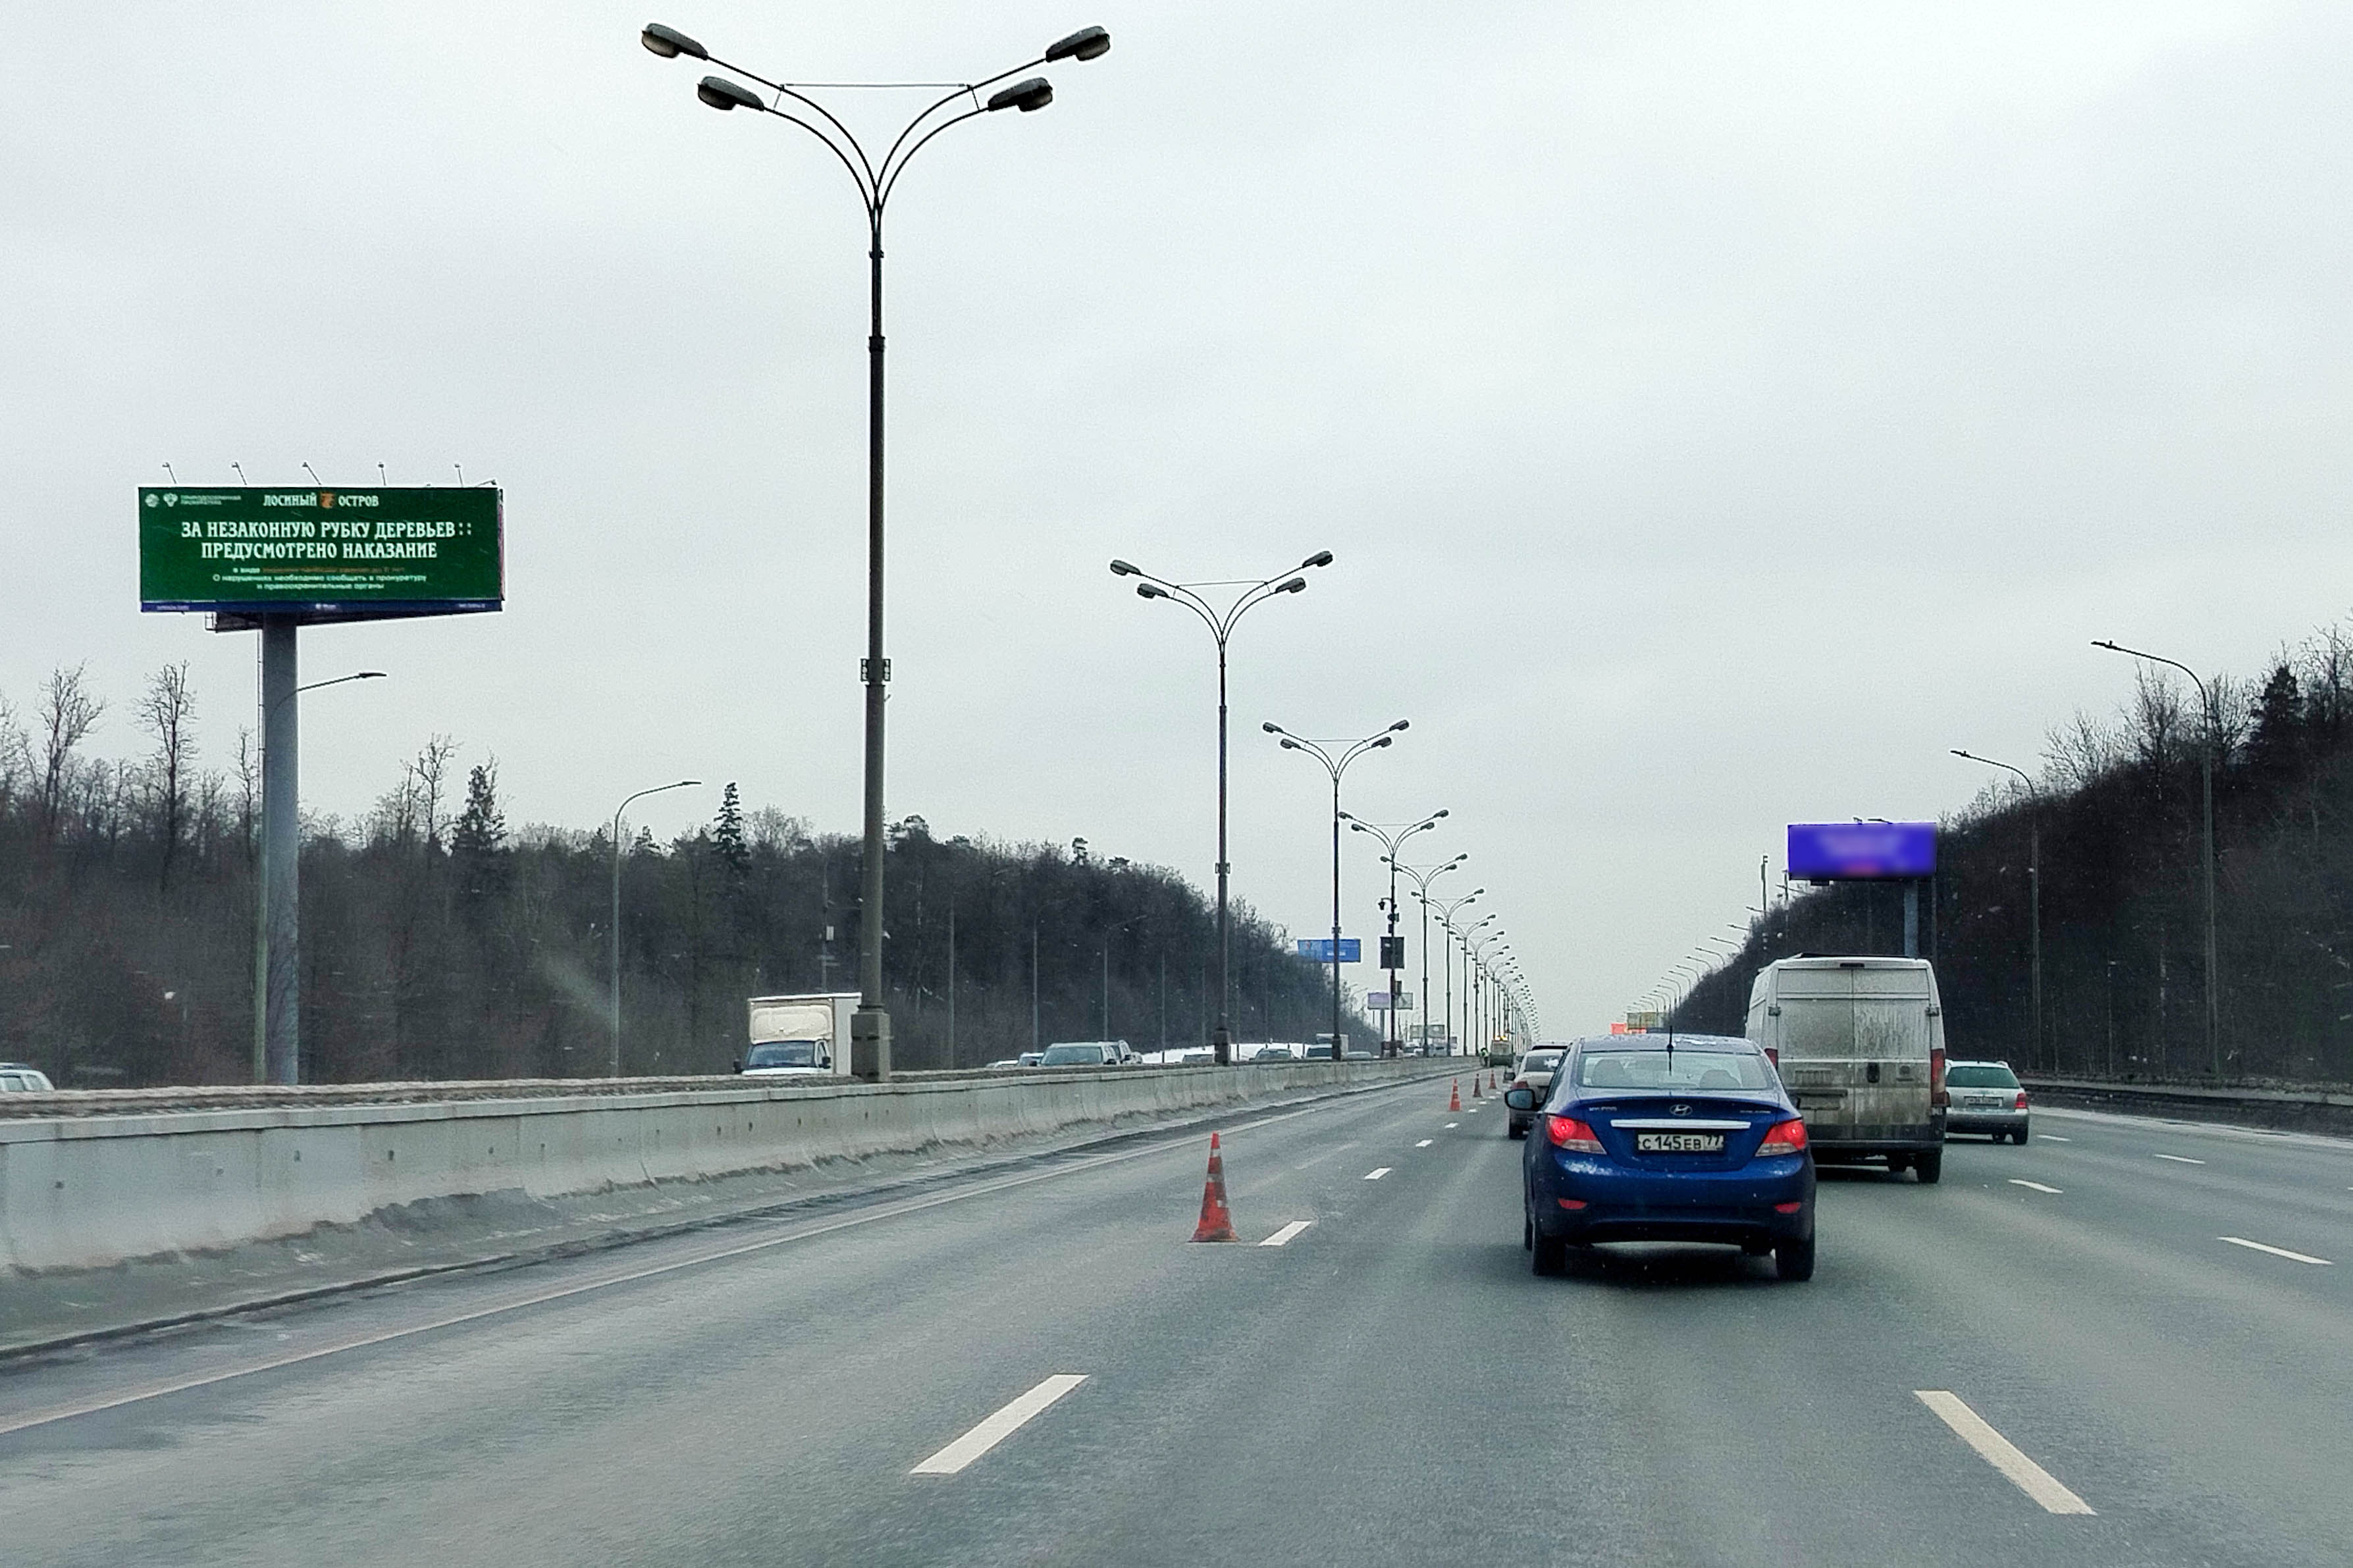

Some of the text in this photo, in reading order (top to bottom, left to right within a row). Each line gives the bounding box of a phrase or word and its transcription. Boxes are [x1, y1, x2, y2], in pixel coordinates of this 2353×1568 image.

[263, 492, 379, 507] ЛОСИНЫЙ ОСТРОВ
[181, 521, 456, 540] ЗА НЕЗАКОННУЮ РУБКУ ДЕРЕВЬЕВ
[201, 542, 437, 562] ПРЕДУСМОТРЕНО НАКАЗАНИЕ
